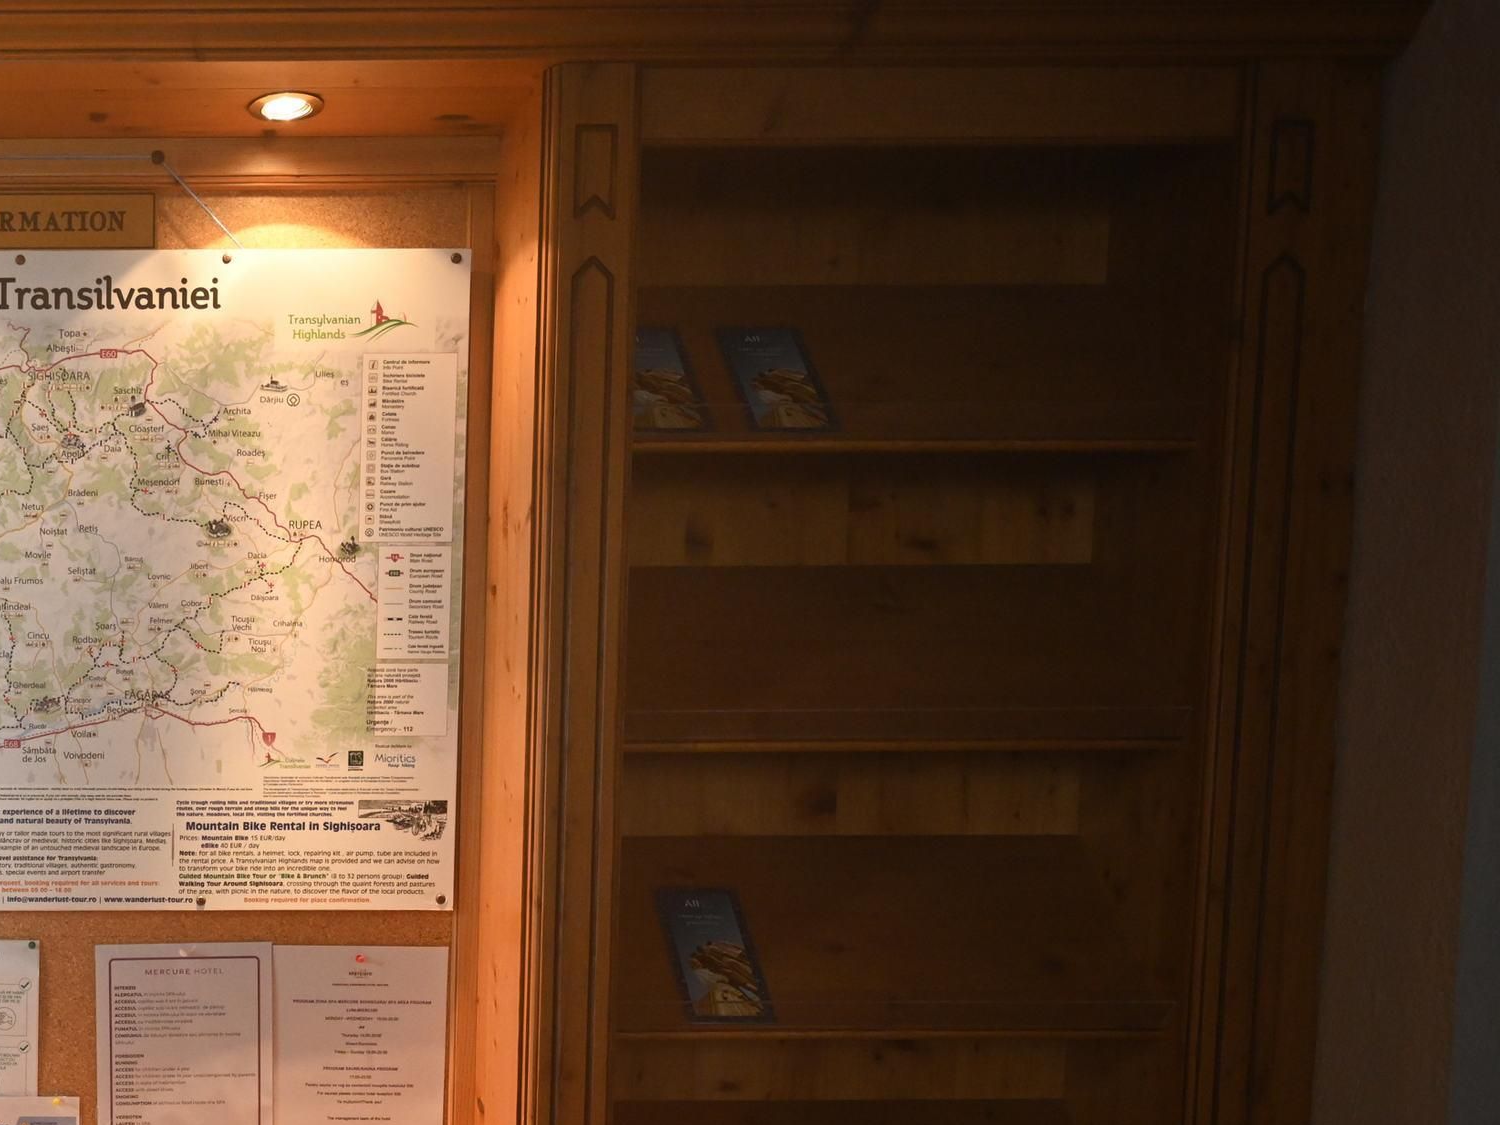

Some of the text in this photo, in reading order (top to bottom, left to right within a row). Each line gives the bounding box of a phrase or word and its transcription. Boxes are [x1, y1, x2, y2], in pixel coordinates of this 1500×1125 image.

[288, 315, 360, 327] Transylvanian
[59, 329, 80, 339] Țopa
[292, 329, 345, 342] Highlands
[101, 350, 116, 358] E60
[113, 386, 143, 394] Saschiz
[223, 407, 251, 415] Archita
[208, 429, 260, 437] Mihai Viteazu
[289, 521, 322, 530] RUPEA
[14, 577, 43, 585] Frumos
[27, 632, 49, 640] Cincu
[13, 682, 46, 690] Gherdeal
[22, 755, 46, 763] de Jos
[63, 752, 105, 760] Voivodeni
[374, 753, 416, 763] Mioritics
[2, 808, 43, 817] experience
[45, 808, 54, 817] of
[55, 808, 60, 817] a
[62, 808, 92, 817] lifetime
[93, 808, 102, 817] to
[104, 808, 136, 817] discover
[186, 821, 239, 833] Mountain
[243, 821, 266, 833] Bike
[270, 821, 305, 833] Rental
[309, 821, 319, 833] in
[145, 968, 224, 976] MERCURE HOTEL
